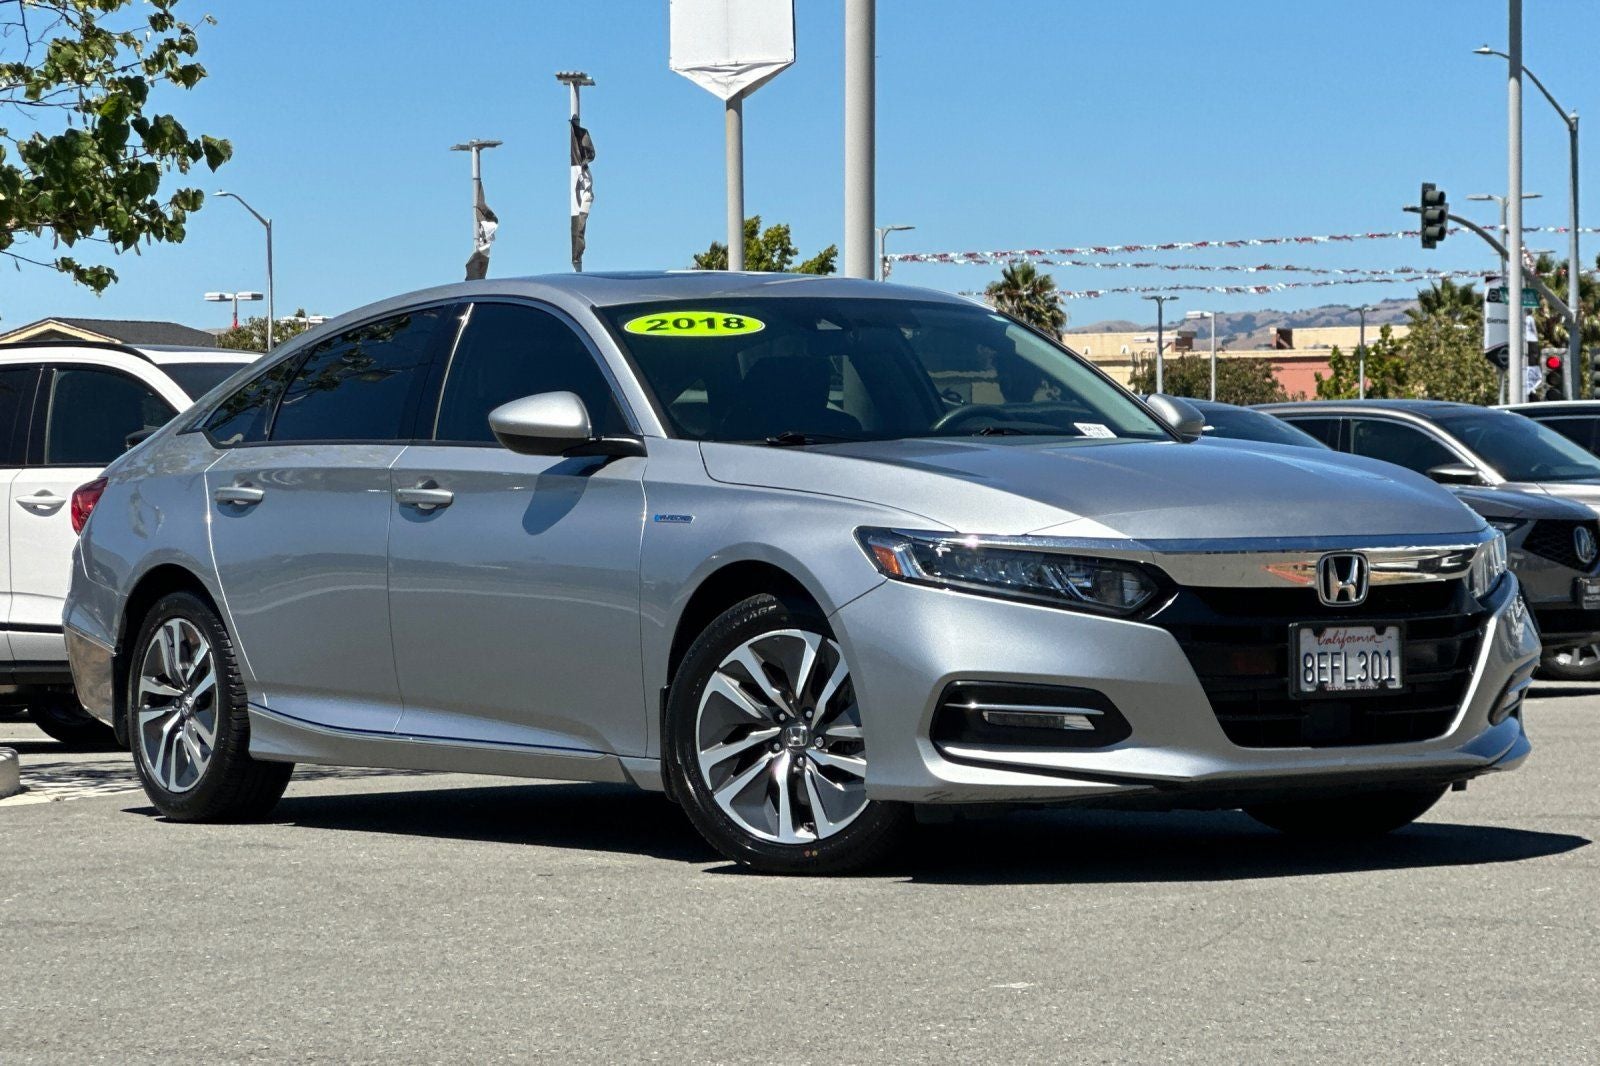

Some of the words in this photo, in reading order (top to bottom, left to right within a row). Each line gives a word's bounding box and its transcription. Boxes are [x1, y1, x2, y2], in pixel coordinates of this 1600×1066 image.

[645, 317, 746, 332] 2018
[1318, 629, 1384, 649] California
[1303, 649, 1396, 684] 8EFL301
